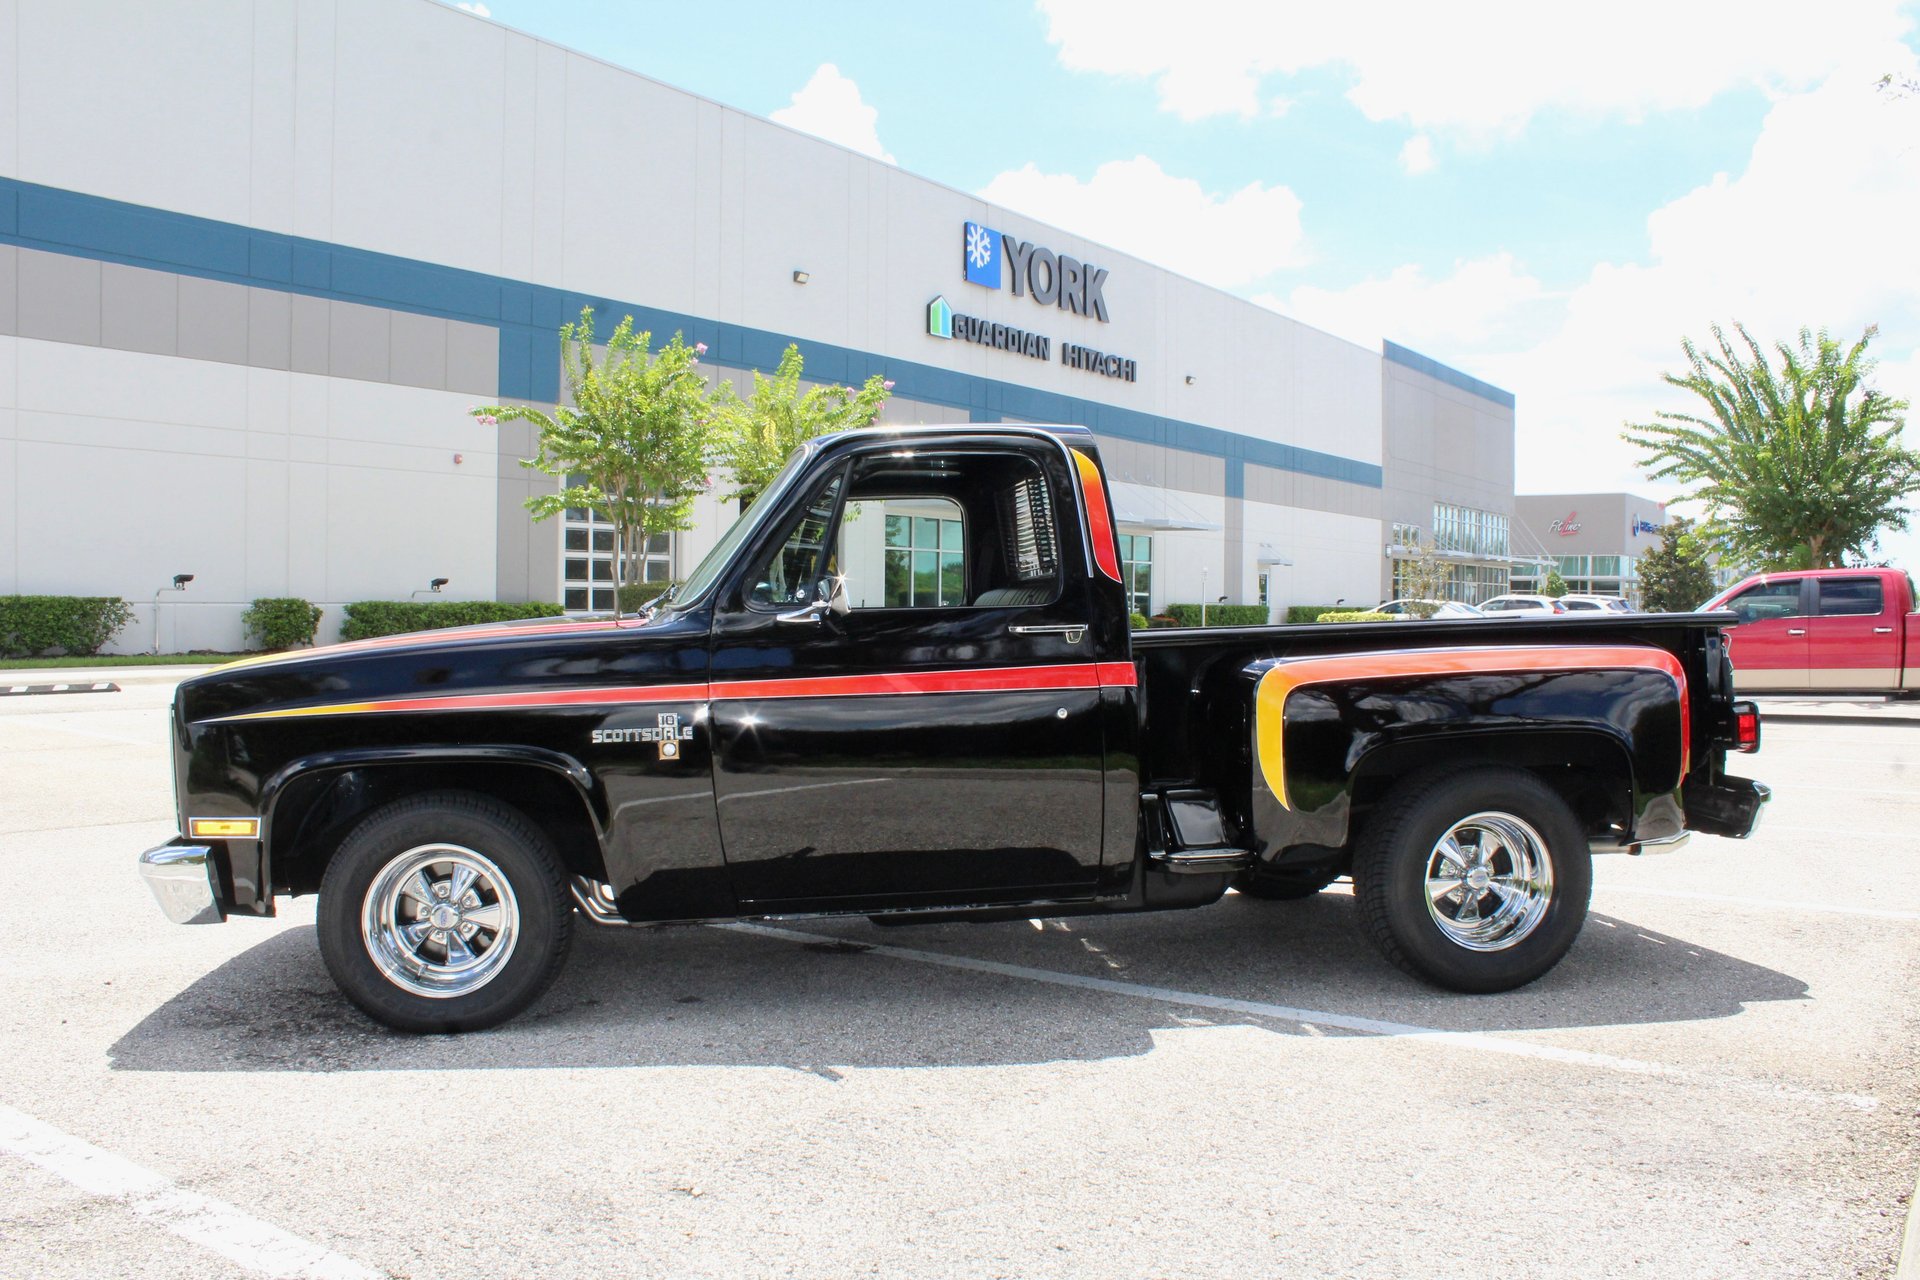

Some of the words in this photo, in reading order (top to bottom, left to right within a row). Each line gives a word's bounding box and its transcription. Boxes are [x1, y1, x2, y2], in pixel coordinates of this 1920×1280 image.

[1002, 234, 1109, 323] YORK
[952, 313, 1050, 361] GUARDIAN
[1062, 343, 1137, 383] HITACHI
[592, 727, 693, 743] SCOTTSDALE
[660, 714, 676, 726] 10
